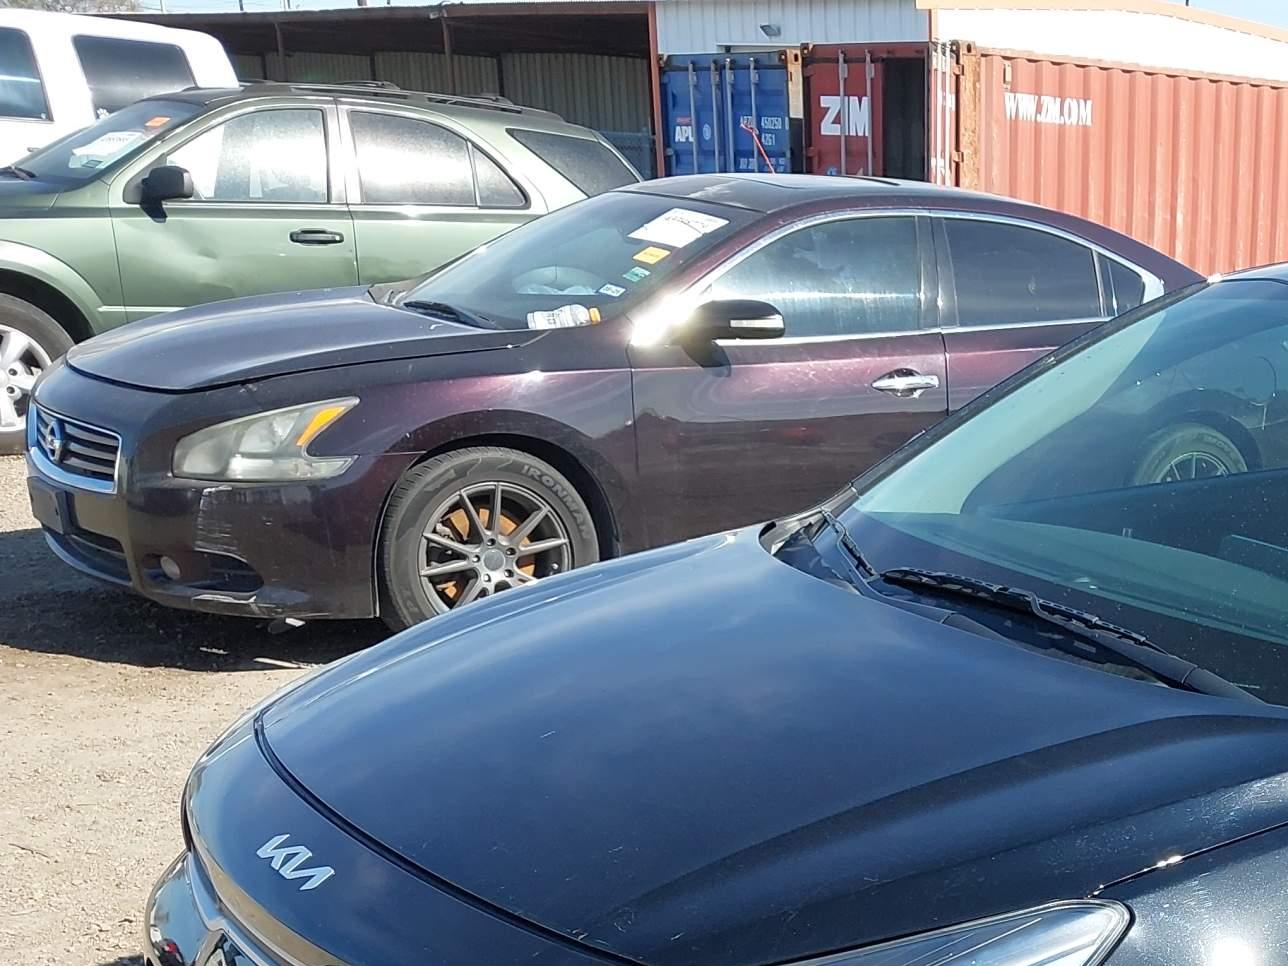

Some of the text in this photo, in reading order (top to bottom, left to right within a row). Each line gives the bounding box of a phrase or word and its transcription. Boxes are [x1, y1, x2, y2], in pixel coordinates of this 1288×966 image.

[674, 125, 695, 142] APL
[820, 95, 871, 136] ZIM
[521, 464, 592, 539] IRONMAN
[256, 833, 336, 891] KIA
